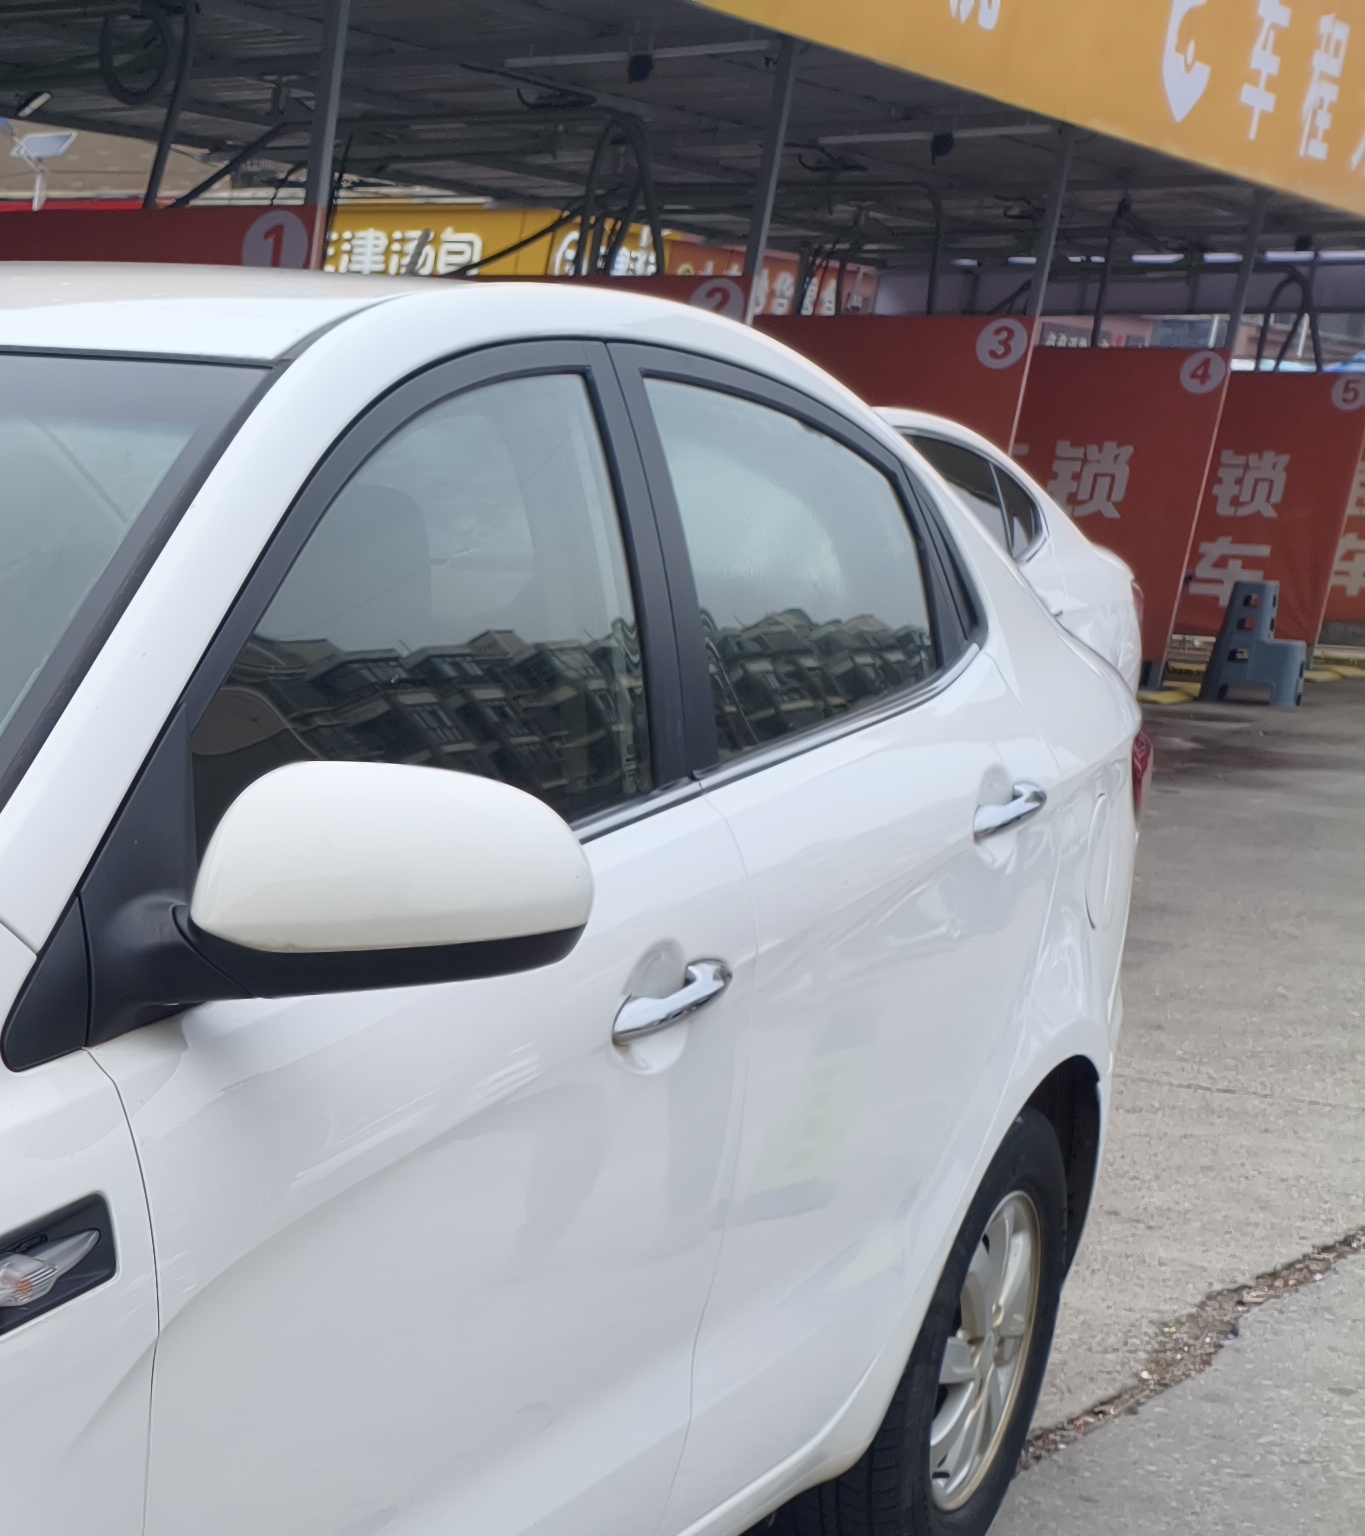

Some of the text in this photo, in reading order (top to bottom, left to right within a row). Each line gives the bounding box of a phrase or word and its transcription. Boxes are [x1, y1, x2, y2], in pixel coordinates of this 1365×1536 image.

[988, 327, 1016, 361] 3
[1190, 357, 1213, 385] 4
[1341, 378, 1361, 404] 5
